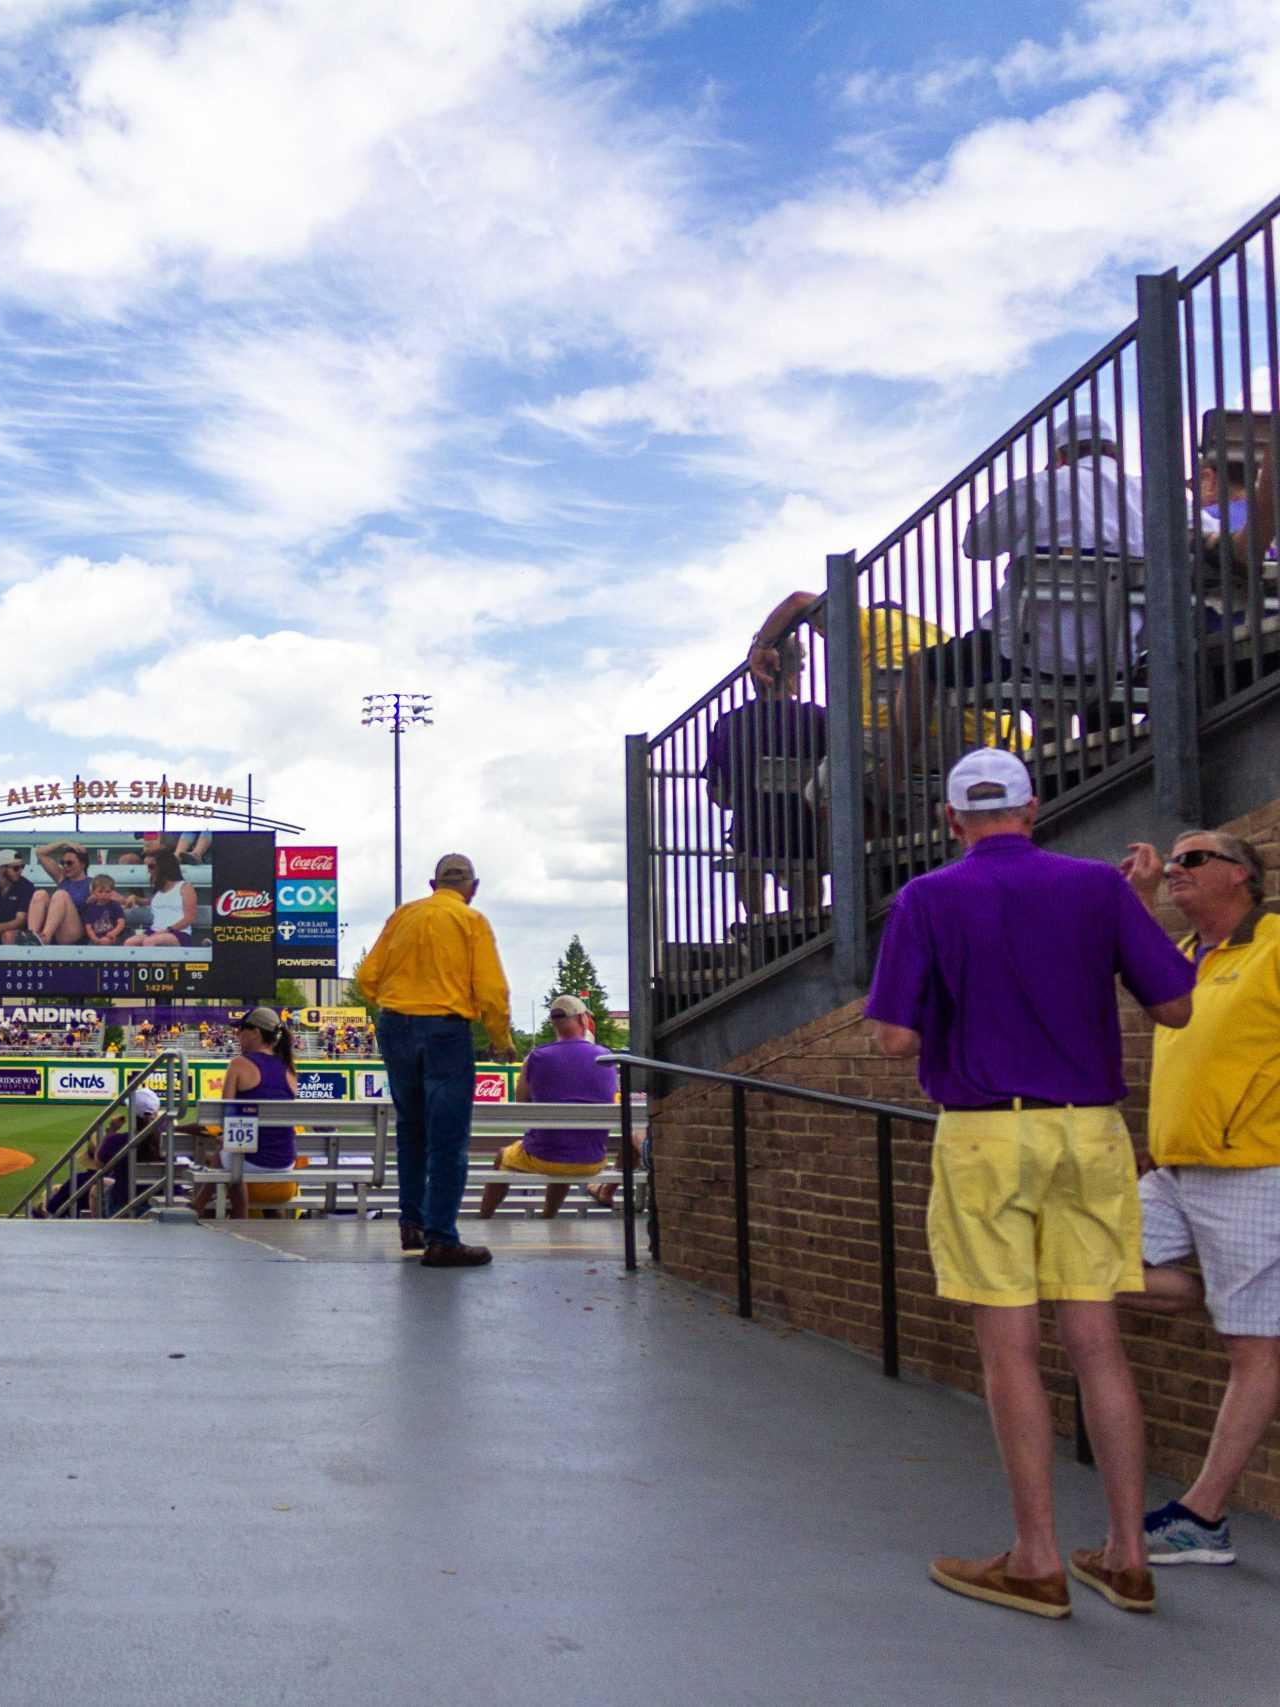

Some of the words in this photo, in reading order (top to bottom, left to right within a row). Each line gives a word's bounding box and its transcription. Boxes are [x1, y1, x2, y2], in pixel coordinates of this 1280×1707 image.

[6, 783, 62, 806] ALEX
[73, 780, 118, 799] BOX
[129, 780, 234, 806] STADIUM
[166, 803, 215, 819] FIELD
[290, 855, 334, 871] Coca-Cola
[278, 886, 336, 906] COX
[216, 890, 271, 916] Cane's
[214, 926, 275, 934] PITCHING
[217, 934, 273, 942] CHANGE
[277, 958, 337, 967] POWERADE
[138, 968, 148, 981] 0
[154, 968, 164, 981] 0
[172, 969, 179, 980] 1
[228, 1011, 247, 1019] LS
[296, 1083, 334, 1091] CAMPUS
[296, 1091, 334, 1099] FEDERAL
[227, 1129, 254, 1143] 105
